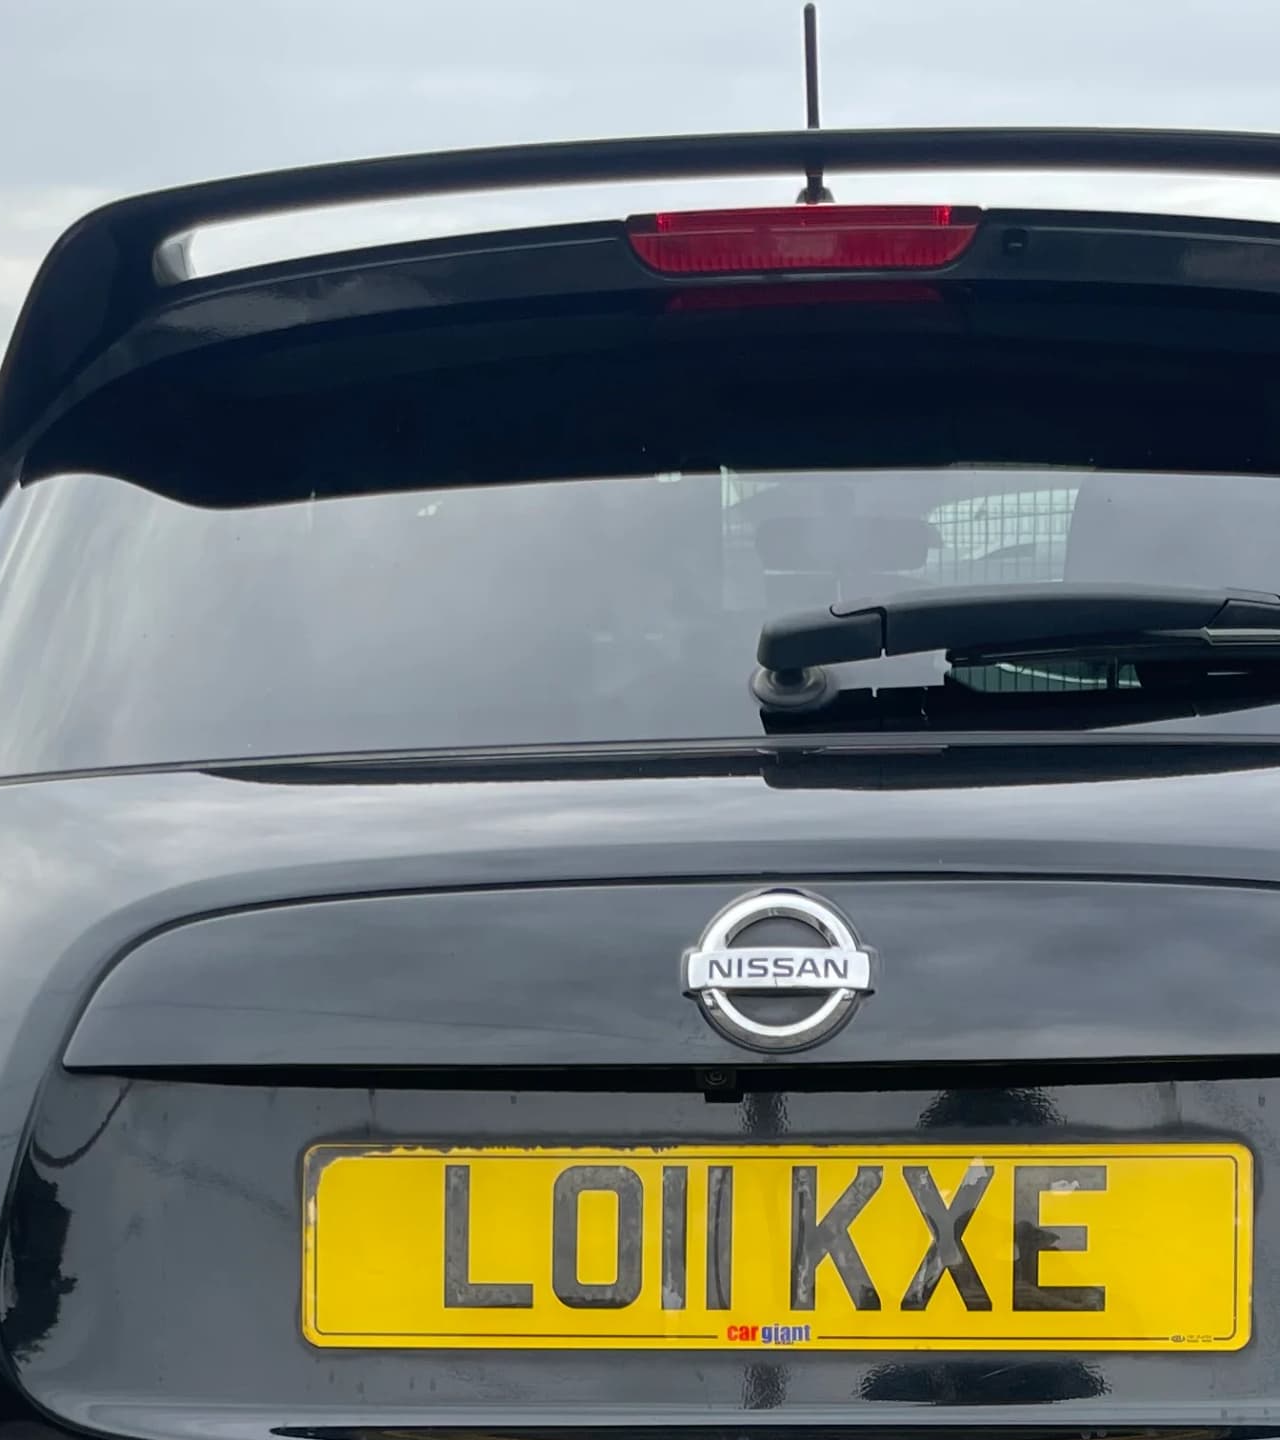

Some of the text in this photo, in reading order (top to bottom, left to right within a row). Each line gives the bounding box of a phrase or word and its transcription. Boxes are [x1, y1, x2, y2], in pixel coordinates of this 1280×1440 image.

[708, 957, 849, 979] NISSAN
[443, 1165, 1107, 1312] LO11 KXE
